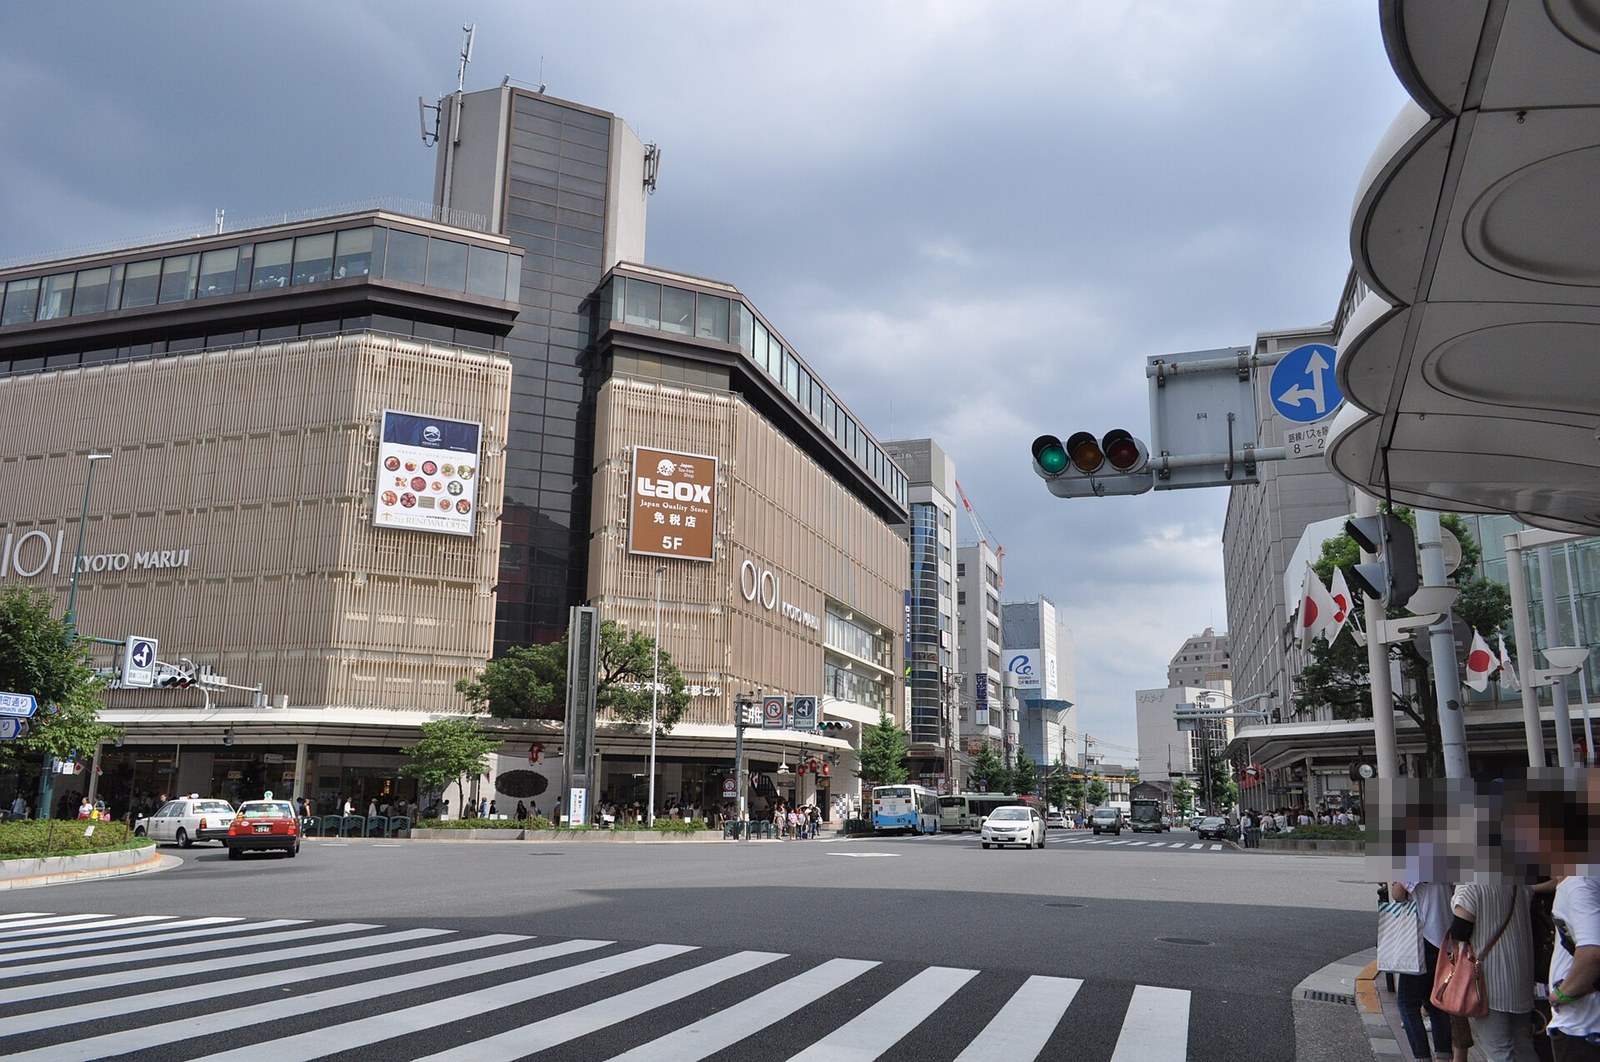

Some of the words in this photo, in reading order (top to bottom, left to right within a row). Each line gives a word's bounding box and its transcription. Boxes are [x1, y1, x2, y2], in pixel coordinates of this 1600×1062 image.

[662, 502, 688, 512] Quality
[690, 505, 708, 514] Store
[653, 511, 696, 528] 免税店
[662, 536, 682, 550] 5F
[134, 550, 189, 570] MARUI
